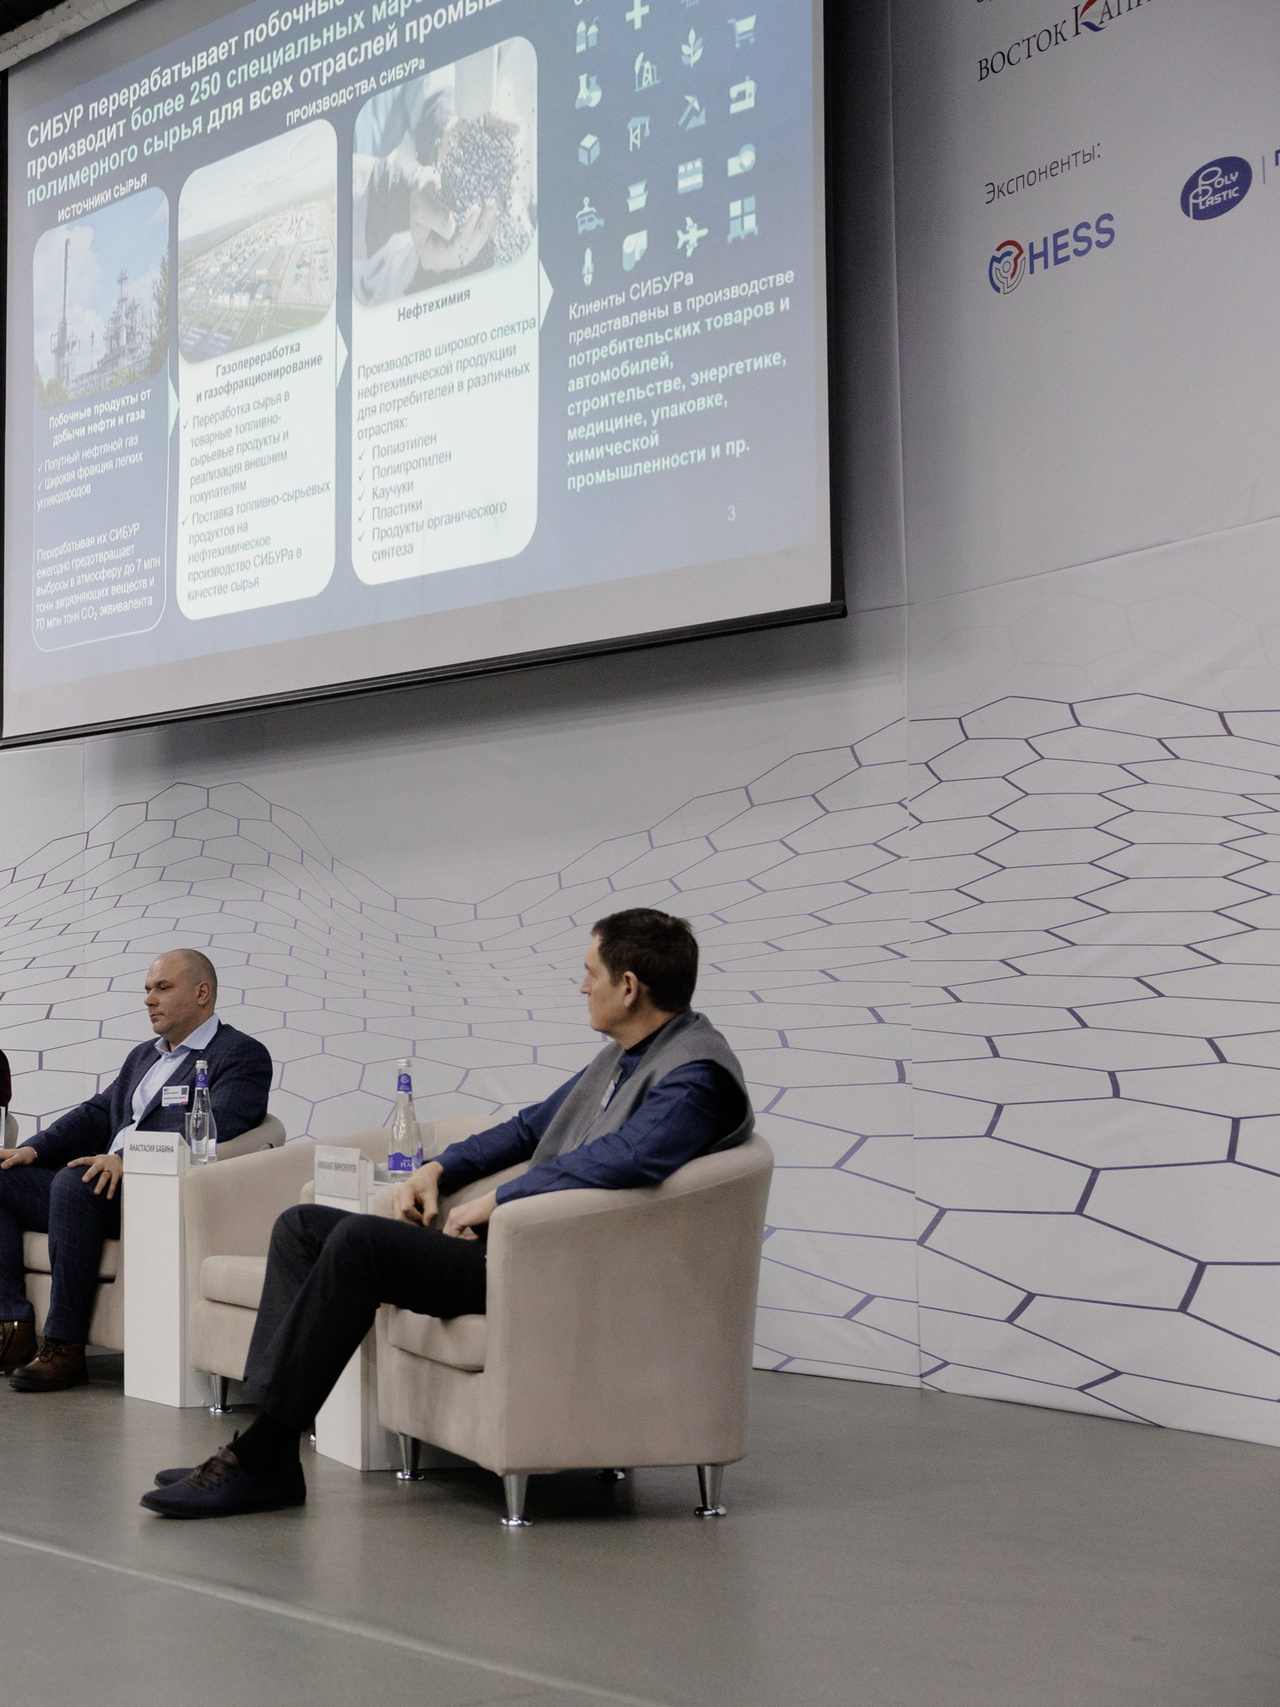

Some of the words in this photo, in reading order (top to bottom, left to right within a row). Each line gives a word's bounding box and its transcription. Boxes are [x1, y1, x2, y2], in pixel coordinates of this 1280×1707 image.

[978, 20, 1067, 82] ВОСТОК
[27, 104, 83, 148] СИБУР
[88, 36, 238, 120] перерабатывает
[27, 119, 126, 179] производит
[131, 94, 185, 131] более
[190, 72, 221, 107] 250
[226, 10, 365, 88] специальных
[286, 76, 376, 126] ПРОИЗВОДСТВА
[379, 57, 425, 86] СИБУРа
[27, 144, 138, 206] полимерного
[143, 115, 203, 156] сырья
[207, 97, 243, 134] для
[249, 74, 294, 112] всех
[300, 23, 398, 87] отраслей
[985, 143, 1101, 204] Экспоненты:
[1198, 167, 1238, 194] POLY
[58, 187, 111, 222] ИСТОЧНИКИ
[113, 173, 148, 198] СЫРЬЯ
[1029, 213, 1115, 275] HESS
[398, 289, 471, 322] Нефтехимия
[569, 291, 625, 320] Клиенты
[630, 271, 694, 300] СИБУРа
[569, 305, 669, 346] представлены
[673, 300, 682, 314] в
[687, 270, 794, 312] производстве
[358, 348, 431, 380] Производство
[434, 332, 487, 357] широкого
[491, 317, 536, 340] спектра
[569, 321, 701, 369] потребительских
[705, 299, 775, 331] товаров
[780, 297, 790, 312] и
[216, 342, 300, 377] Газопереработка
[358, 361, 453, 400] нефтехимической
[456, 344, 516, 372] продукции
[568, 351, 673, 392] автомобилей,
[196, 392, 202, 402] и
[204, 355, 323, 399] газофракционирование
[357, 406, 376, 422] для
[379, 382, 454, 414] потребителей
[457, 380, 463, 392] в
[467, 362, 530, 392] различных
[567, 376, 686, 417] строительстве,
[690, 352, 786, 387] энергетике,
[49, 408, 91, 429] Побочные
[93, 394, 138, 416] продукты
[141, 389, 151, 401] от
[193, 402, 250, 429] Переработка
[253, 393, 281, 411] сырья
[285, 391, 290, 402] в
[567, 412, 647, 442] медицине,
[651, 393, 728, 426] упаковке,
[53, 426, 85, 448] добычи
[88, 418, 115, 434] нефти
[119, 416, 123, 425] и
[126, 409, 145, 422] газа
[190, 428, 232, 448] товарные
[235, 414, 281, 435] топливно-
[358, 417, 408, 440] отраслях:
[372, 433, 437, 460] Полиэтилен
[45, 451, 80, 472] Попутный
[82, 438, 122, 459] нефтяной
[125, 435, 138, 447] газ
[190, 446, 234, 467] сырьевые
[236, 433, 280, 454] продукты
[283, 431, 289, 440] и
[372, 451, 452, 480] Полипропилен
[567, 431, 659, 466] химической
[567, 448, 706, 492] промышленности
[712, 444, 720, 459] и
[726, 439, 750, 458] пр.
[45, 471, 75, 490] Широкая
[77, 460, 113, 481] фракция
[190, 462, 242, 488] реализация
[244, 451, 288, 471] внешним
[190, 481, 246, 504] покупателям
[192, 507, 233, 525] Поставка
[236, 481, 330, 514] топливно-сырьевых
[372, 481, 414, 500] Каучуки
[372, 500, 422, 521] Пластики
[372, 520, 424, 542] Продукты
[427, 501, 507, 530] органического
[728, 505, 735, 521] 3
[97, 533, 107, 544] их
[109, 523, 139, 541] СИБУР
[188, 535, 271, 564] нефтехимическое
[189, 525, 234, 545] продуктов
[237, 522, 248, 533] на
[372, 543, 414, 561] синтеза
[36, 580, 68, 597] выбросы
[70, 577, 74, 586] в
[77, 567, 121, 586] атмосферу
[124, 563, 134, 575] до
[137, 559, 141, 571] 7
[144, 557, 160, 570] млн
[37, 562, 69, 579] ежегодно
[72, 544, 134, 572] предотвращает
[188, 559, 250, 583] производство
[253, 548, 293, 568] СИБУРа
[296, 548, 302, 558] в
[36, 602, 53, 614] тонн
[111, 580, 147, 595] веществ
[149, 577, 154, 586] и
[188, 585, 228, 601] качестве
[231, 577, 259, 592] сырья
[36, 618, 45, 631] 70
[47, 618, 61, 629] млн
[64, 613, 79, 624] тонн
[129, 1144, 155, 1152] АНАСТАСИЯ
